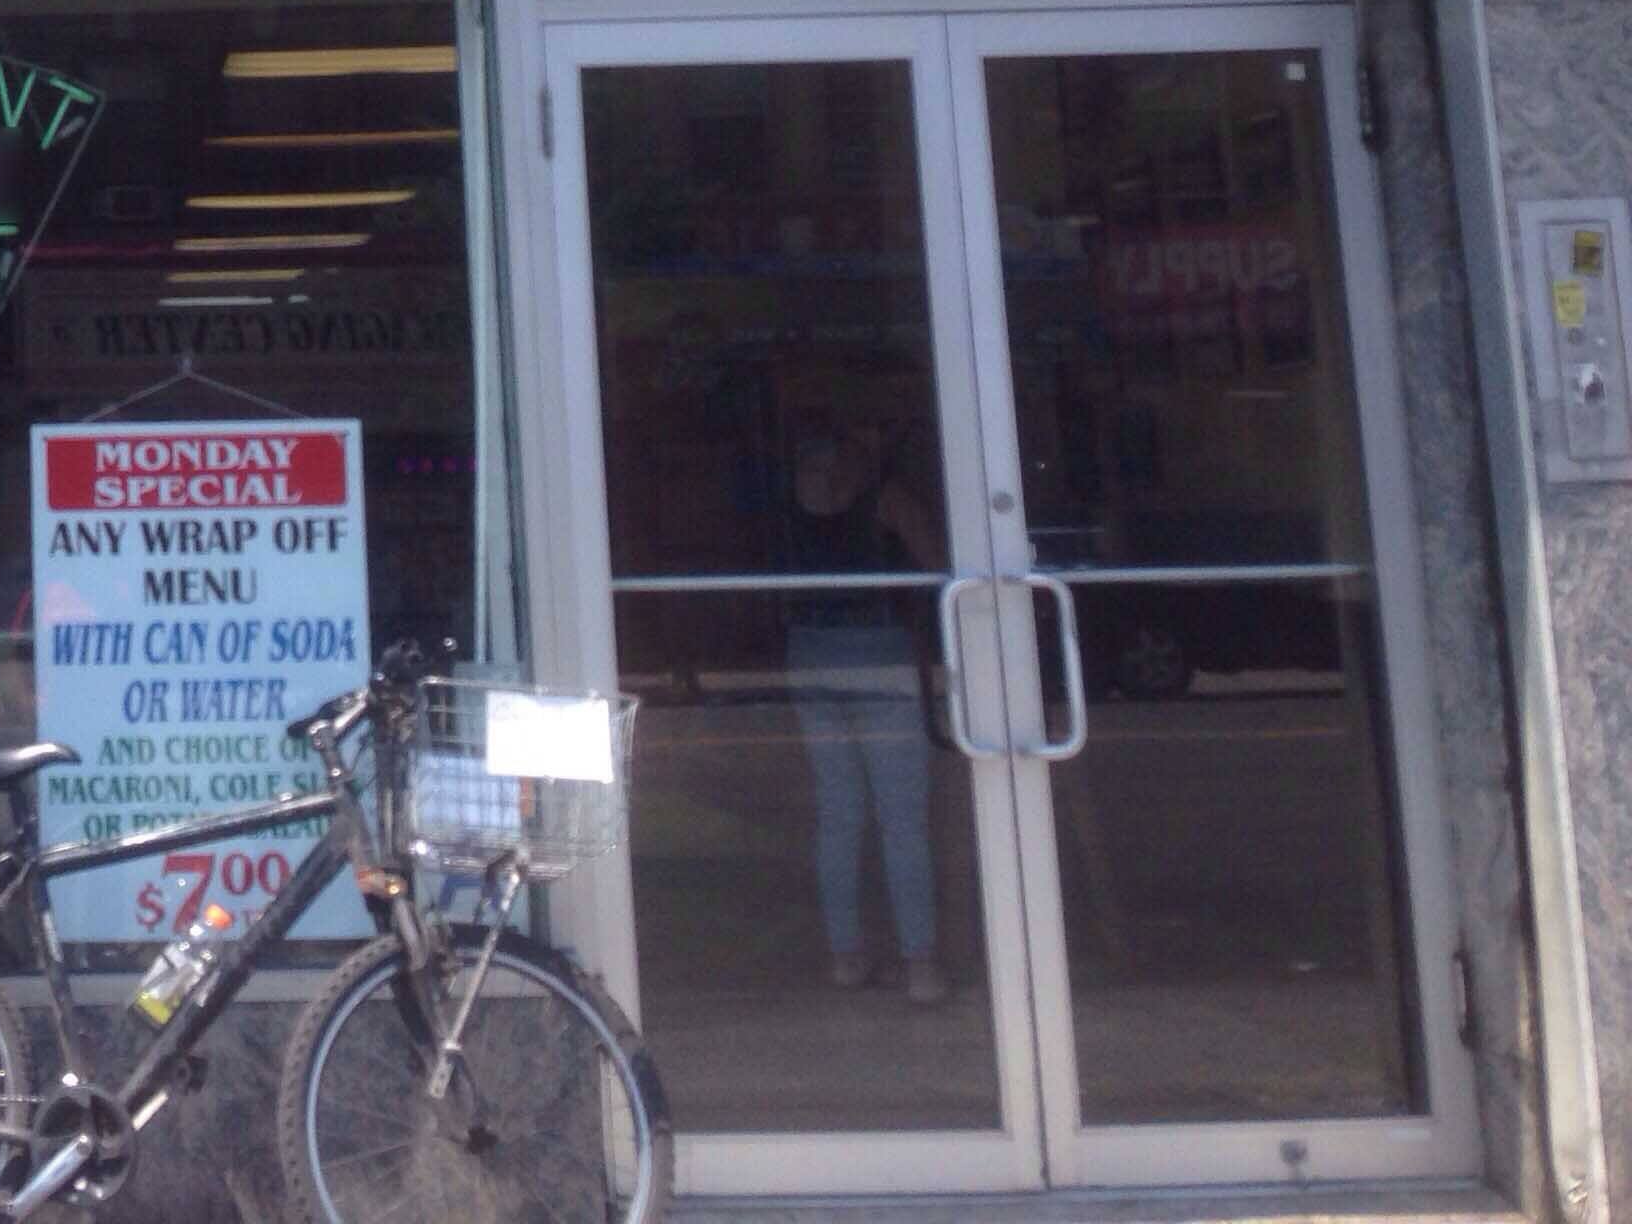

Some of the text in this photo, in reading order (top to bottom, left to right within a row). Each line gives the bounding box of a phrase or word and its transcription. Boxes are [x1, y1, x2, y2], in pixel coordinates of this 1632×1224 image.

[95, 439, 300, 471] MONDAY
[93, 474, 302, 507] SPECIAL
[50, 517, 348, 556] ANY WRAP OFF
[143, 570, 257, 606] MENU
[52, 618, 356, 665] WITH CAN OF SODA
[123, 678, 288, 724] OR WATER
[96, 737, 155, 766] AND
[164, 736, 269, 765] CHOICE
[47, 775, 201, 805] MACARONI,
